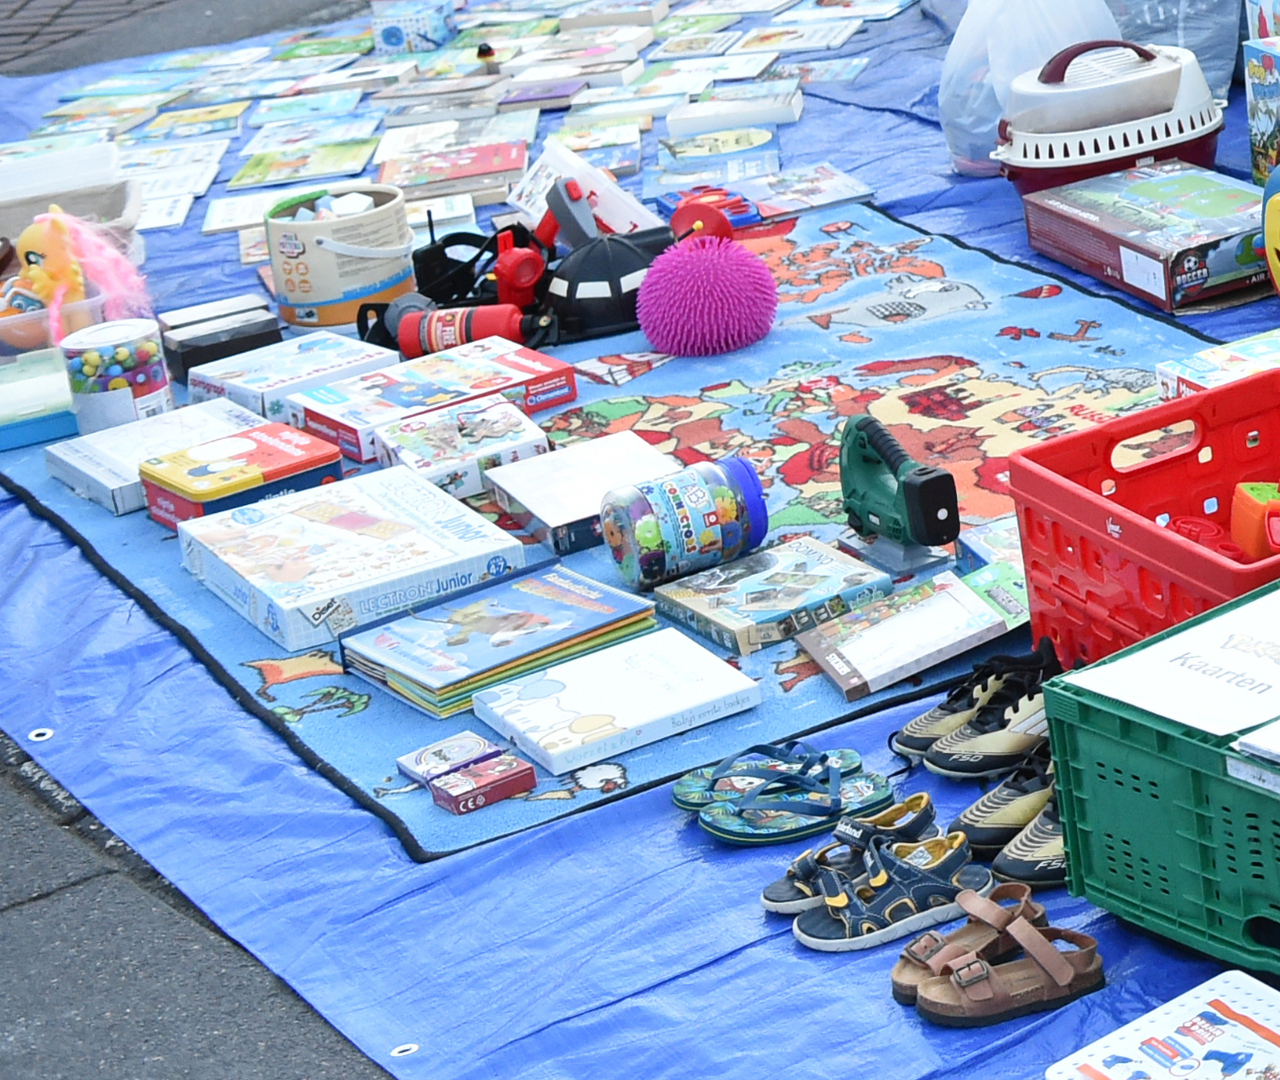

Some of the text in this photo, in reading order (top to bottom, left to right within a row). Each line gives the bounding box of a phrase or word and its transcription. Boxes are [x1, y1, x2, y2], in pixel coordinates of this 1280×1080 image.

[1175, 268, 1210, 287] SOCCER
[1250, 274, 1266, 284] AIR
[359, 572, 474, 614] LECTRON Junior
[1169, 651, 1273, 695] Kaarten
